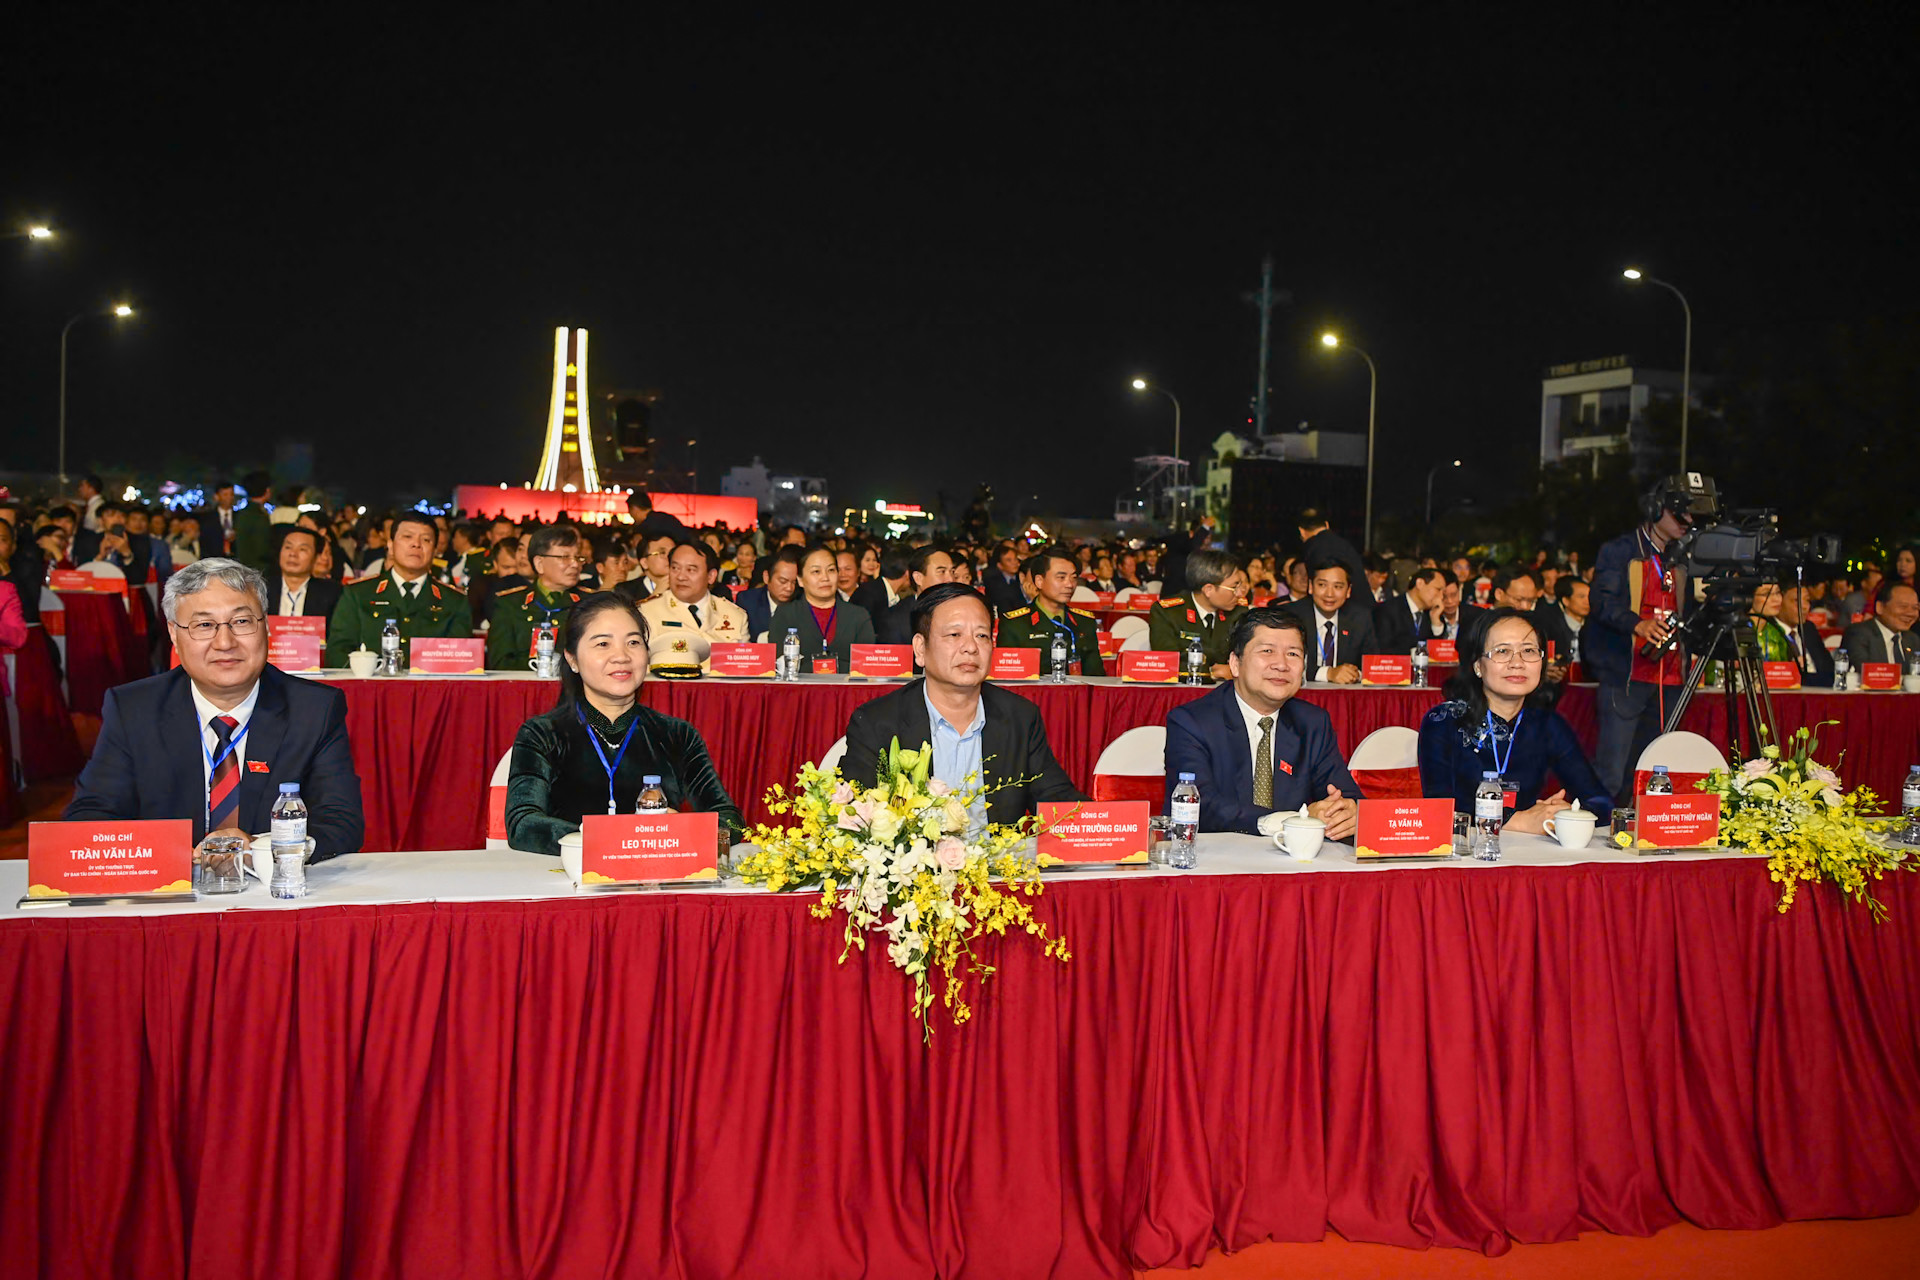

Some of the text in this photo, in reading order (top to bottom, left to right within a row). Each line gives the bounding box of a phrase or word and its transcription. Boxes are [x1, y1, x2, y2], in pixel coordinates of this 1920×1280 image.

[1694, 475, 1699, 484] 4
[1647, 812, 1669, 822] NGUYỄN
[1671, 814, 1680, 823] THỊ
[635, 824, 668, 833] ĐỒNG CHÍ
[1049, 822, 1137, 833] NGUYỄN TRƯỜNG GIANG
[1389, 818, 1422, 829] TẠ VĂN HẠ
[93, 833, 132, 842] ĐỒNG CHÍ
[622, 839, 679, 850] LEO THỊ LỊCH
[70, 846, 152, 860] TRẦN VĂN LÂM
